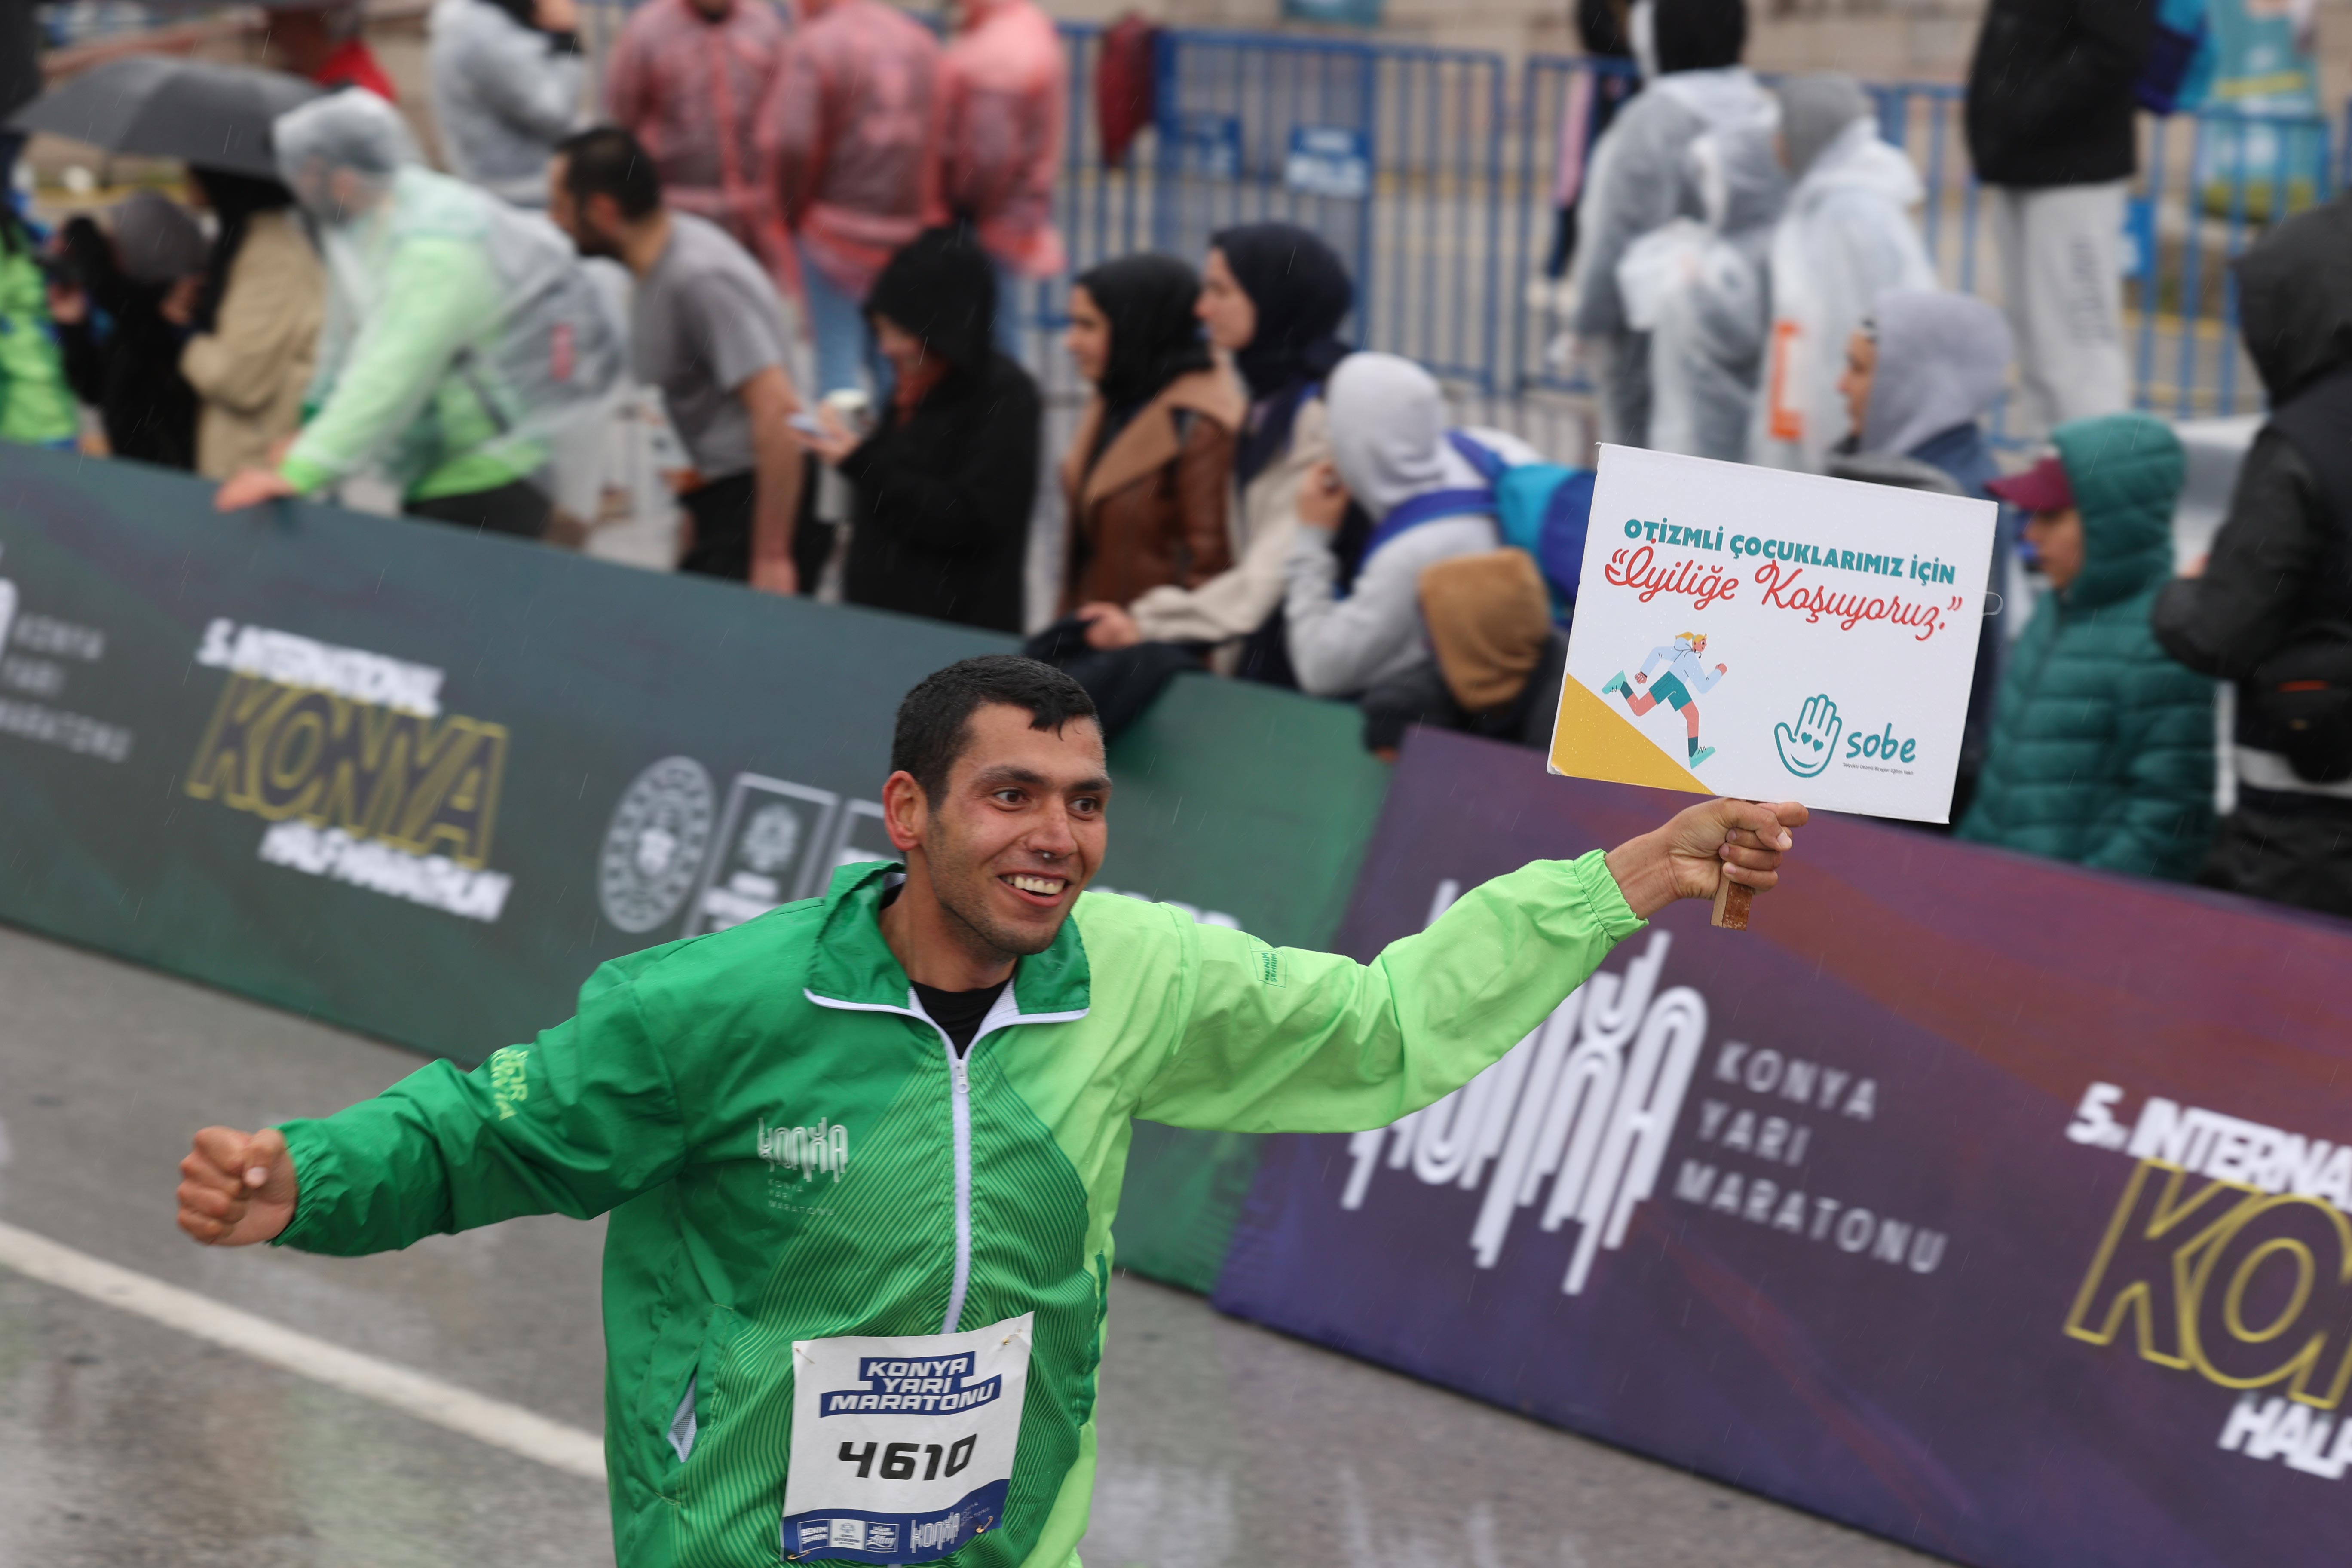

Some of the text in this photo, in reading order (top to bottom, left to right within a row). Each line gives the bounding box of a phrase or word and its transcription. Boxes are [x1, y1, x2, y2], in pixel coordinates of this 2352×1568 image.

[1624, 517, 1956, 586] OTİZMLİ ÇOCUKLARIMIZ İÇİN
[185, 669, 509, 870] KONYA
[1846, 722, 1916, 763] sobe
[1715, 1039, 1877, 1122] KONYA
[1697, 1097, 1813, 1167] YARI
[1673, 1158, 1949, 1274] MARATONU
[865, 1357, 969, 1377] KONYA
[882, 1377, 953, 1393] YARI
[828, 1381, 996, 1412] MARATONU
[838, 1433, 977, 1481] 4610
